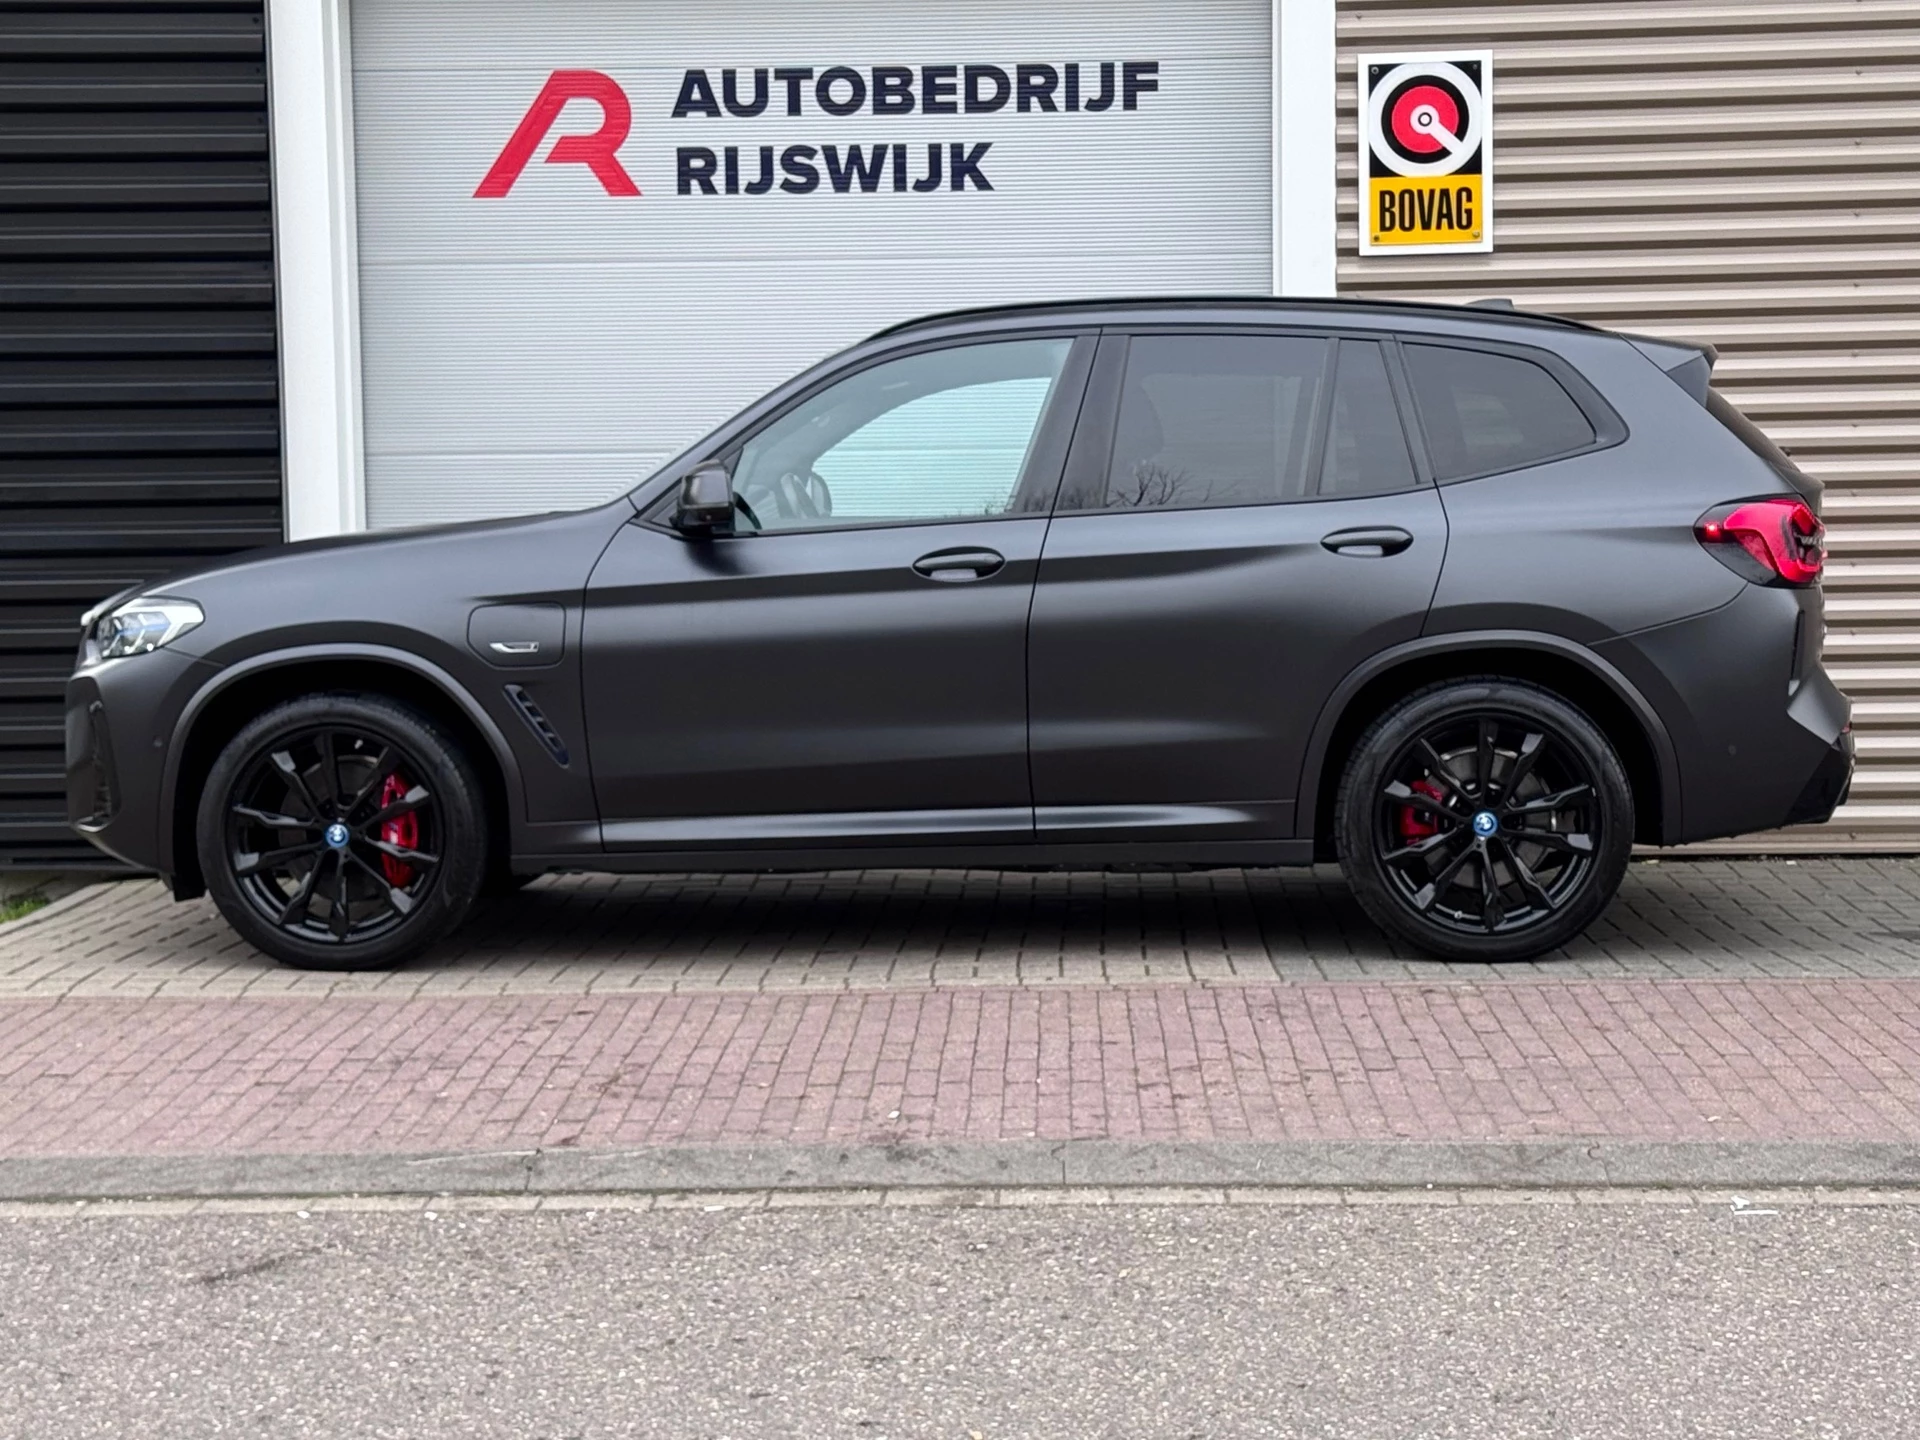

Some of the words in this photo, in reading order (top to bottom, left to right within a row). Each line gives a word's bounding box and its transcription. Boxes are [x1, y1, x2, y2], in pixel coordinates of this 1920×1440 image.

[671, 61, 1159, 118] AUTOBEDRIJF
[676, 142, 995, 196] RIJSWIJK
[1379, 187, 1473, 232] BOVAG
